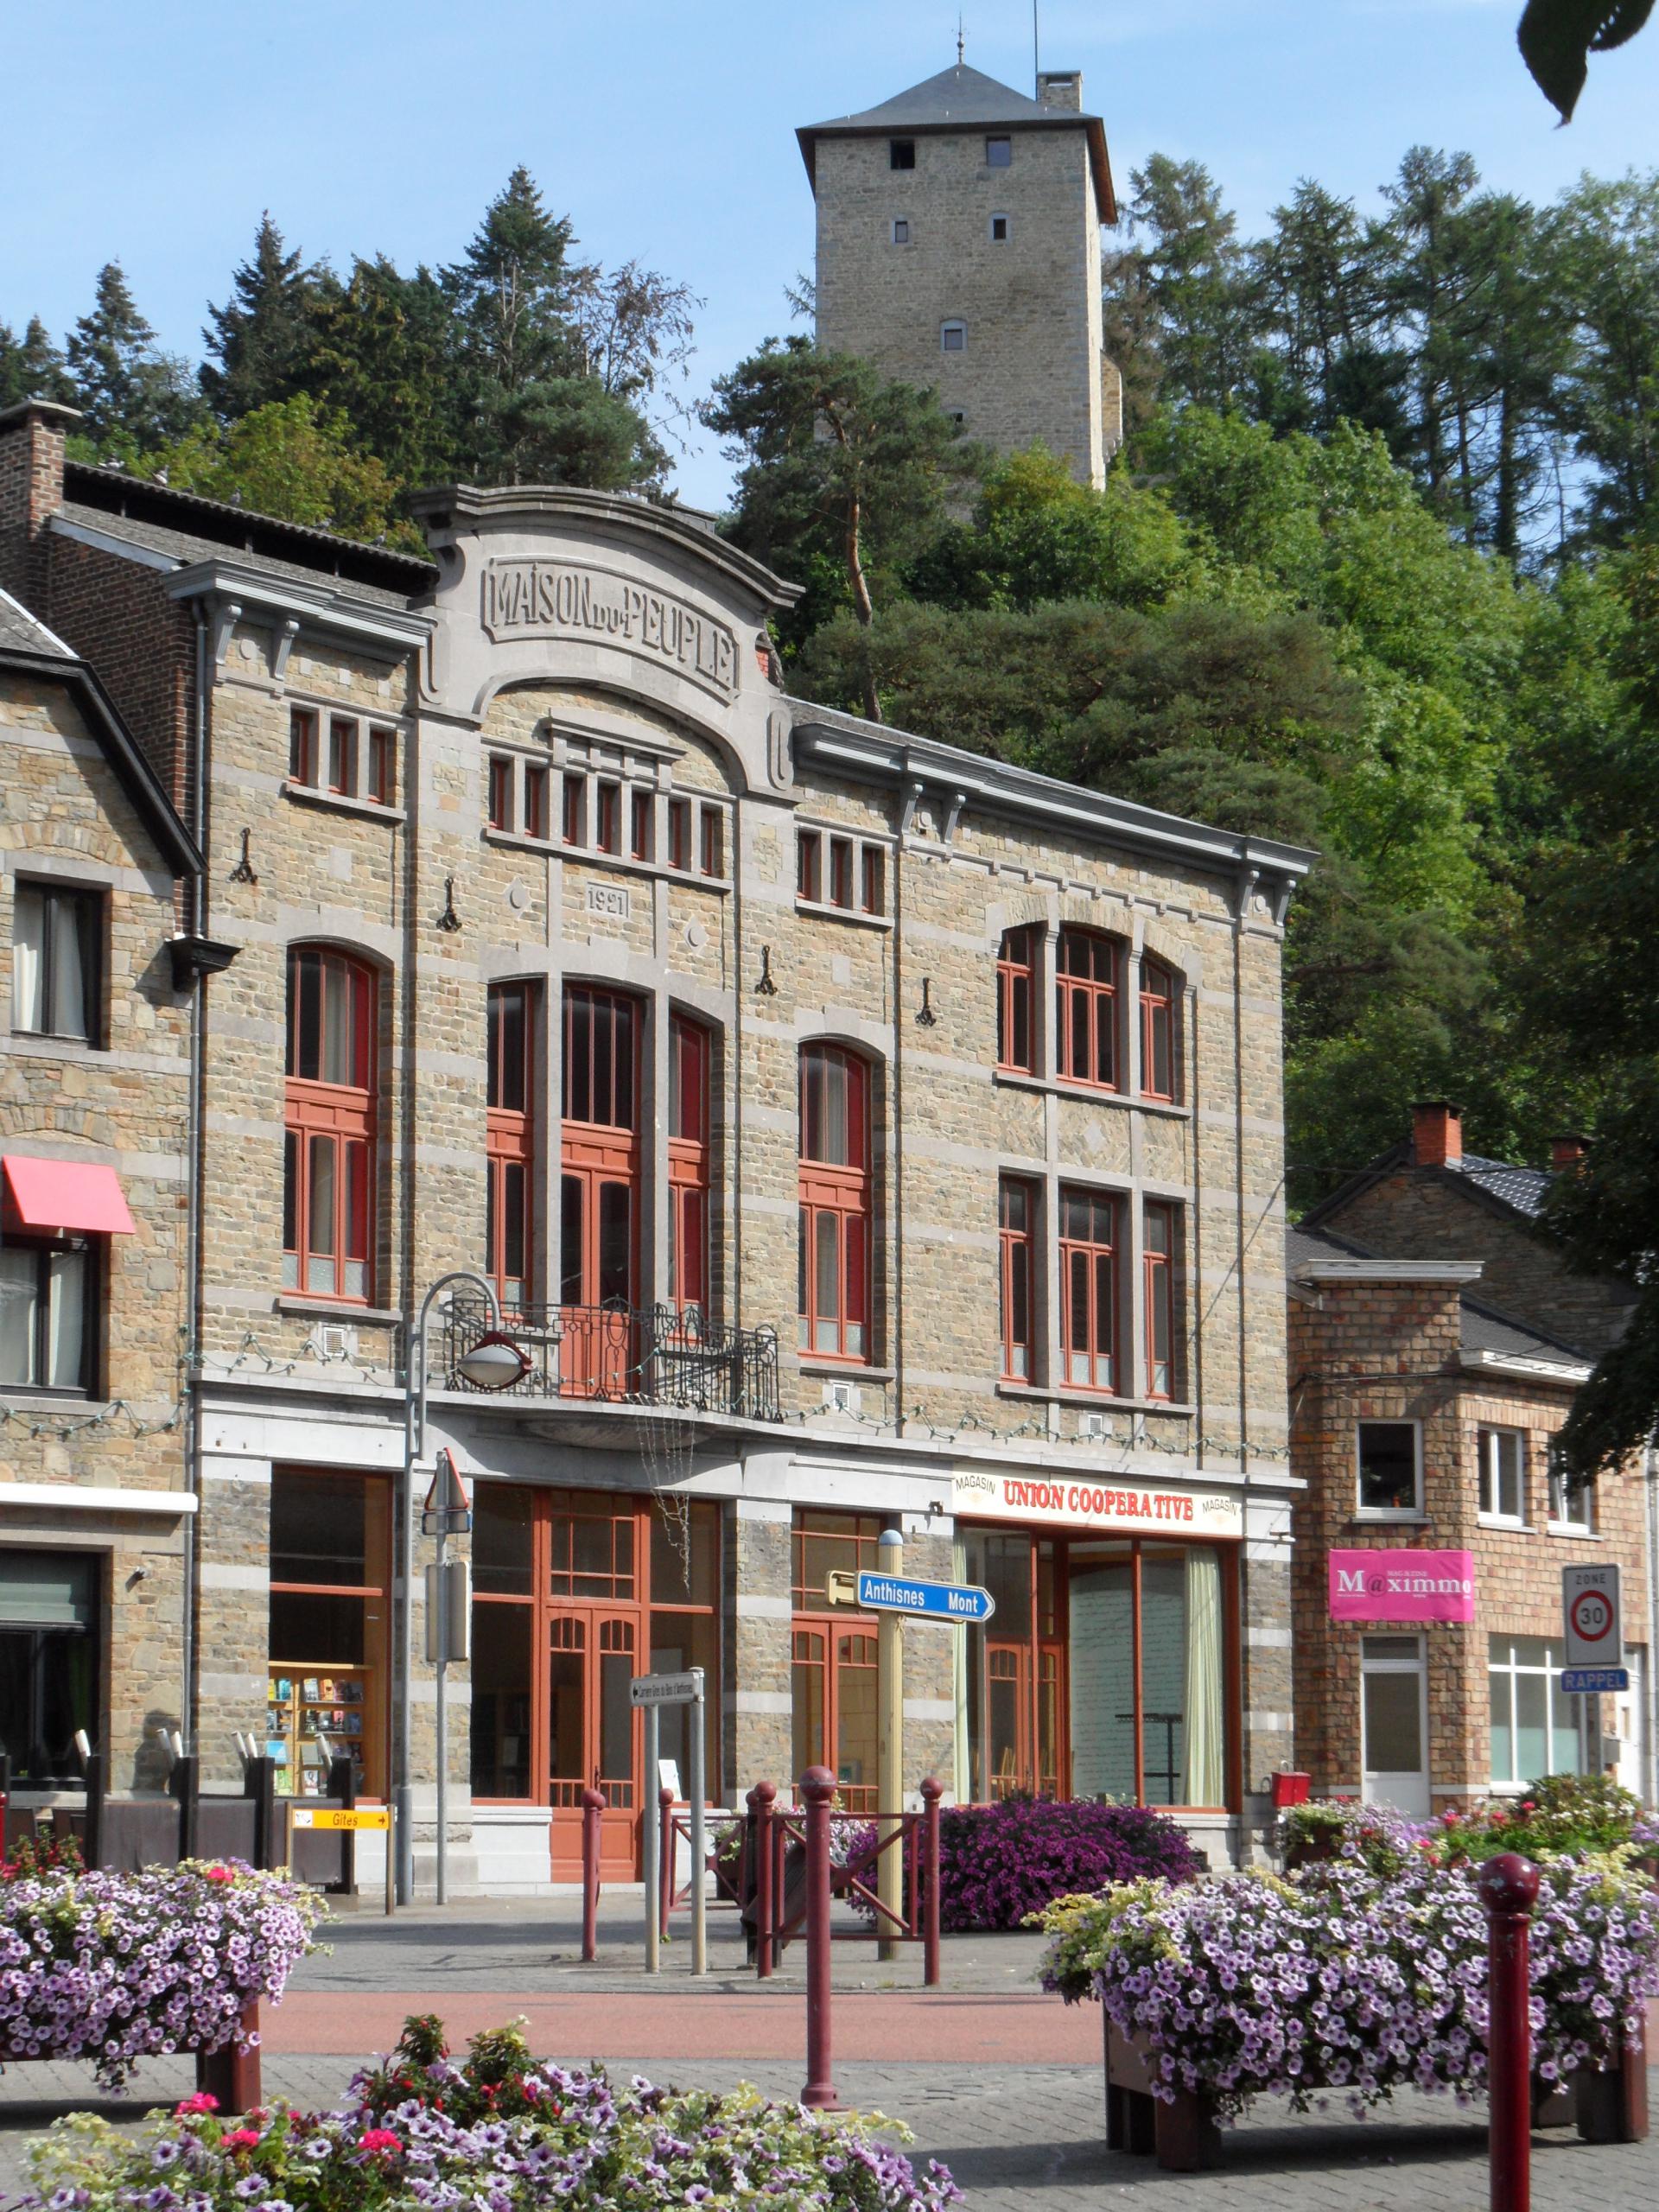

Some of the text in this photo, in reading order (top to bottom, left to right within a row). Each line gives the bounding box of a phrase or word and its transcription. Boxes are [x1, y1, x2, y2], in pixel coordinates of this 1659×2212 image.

[490, 564, 593, 628] MAISON
[621, 586, 732, 692] PEUPLE
[955, 1477, 996, 1496] MAGASIN
[1003, 1480, 1193, 1521] UNION COOPERATIVE
[1202, 1497, 1238, 1516] MAGASIN
[1575, 1573, 1606, 1585] ZONE
[864, 1579, 979, 1613] Anthisnes Mont
[1580, 1606, 1604, 1624] 30
[1565, 1672, 1624, 1689] RAPPEL
